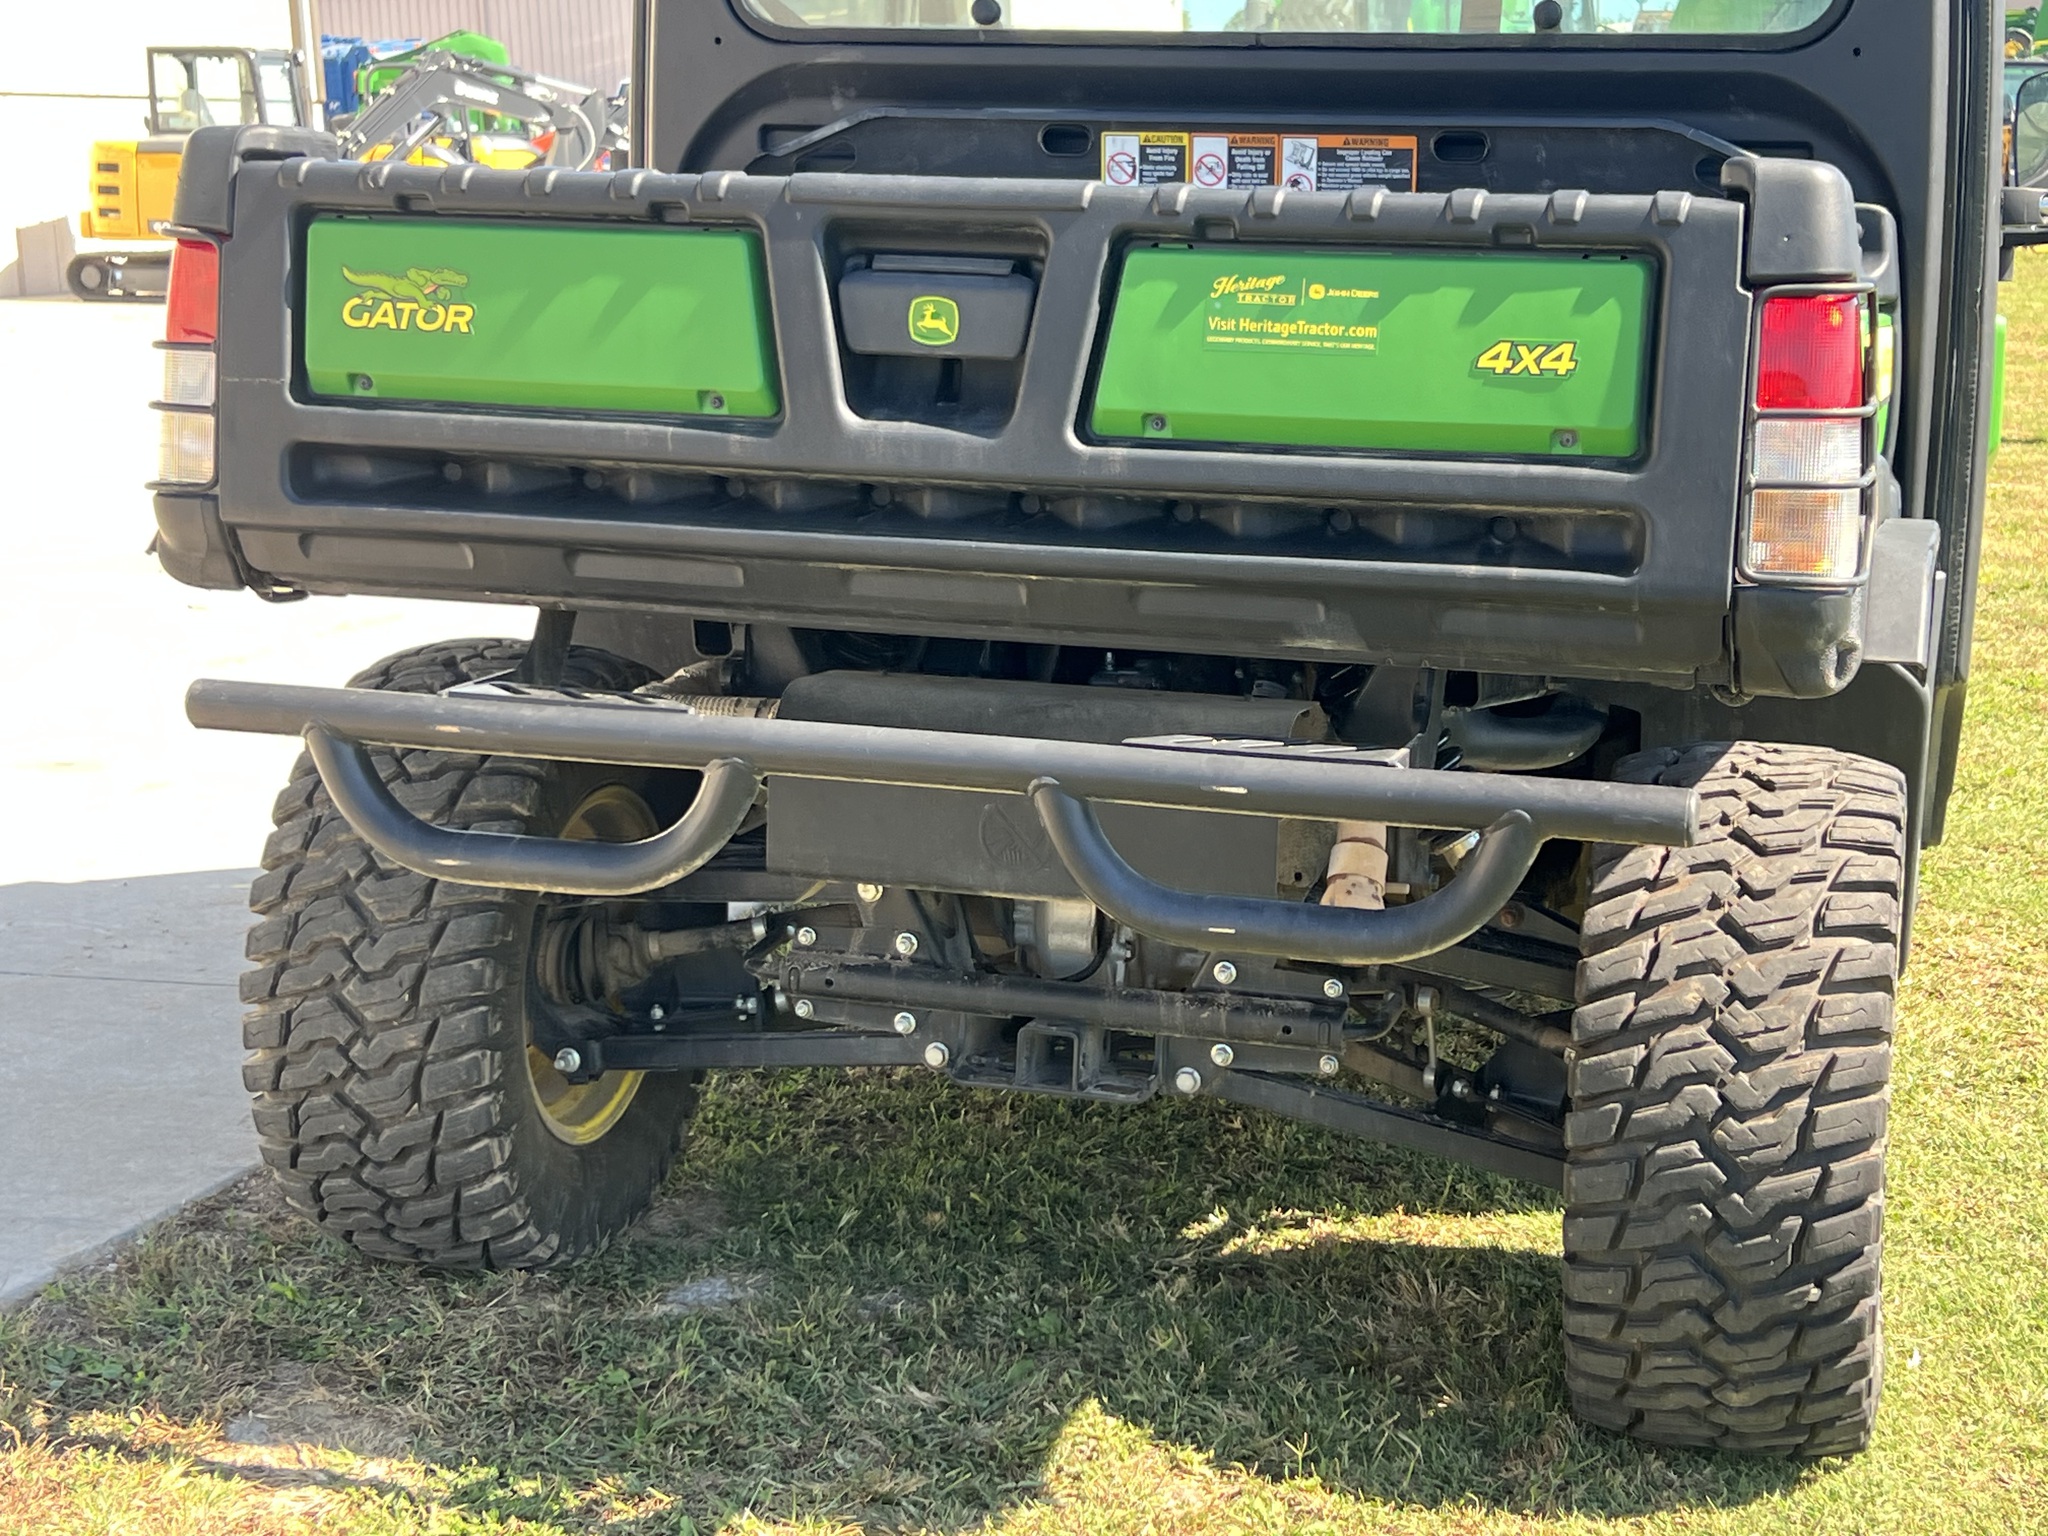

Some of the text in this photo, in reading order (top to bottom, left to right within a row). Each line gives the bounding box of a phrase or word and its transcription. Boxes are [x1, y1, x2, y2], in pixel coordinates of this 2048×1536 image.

[1152, 135, 1184, 144] CAUTION
[1239, 137, 1276, 145] WARNING
[1352, 138, 1389, 147] WARNING
[1210, 274, 1287, 298] Heritage
[1237, 293, 1297, 306] TRACTOR
[341, 296, 475, 335] GATOR
[1208, 316, 1378, 338] Visit HeritageTractor.com
